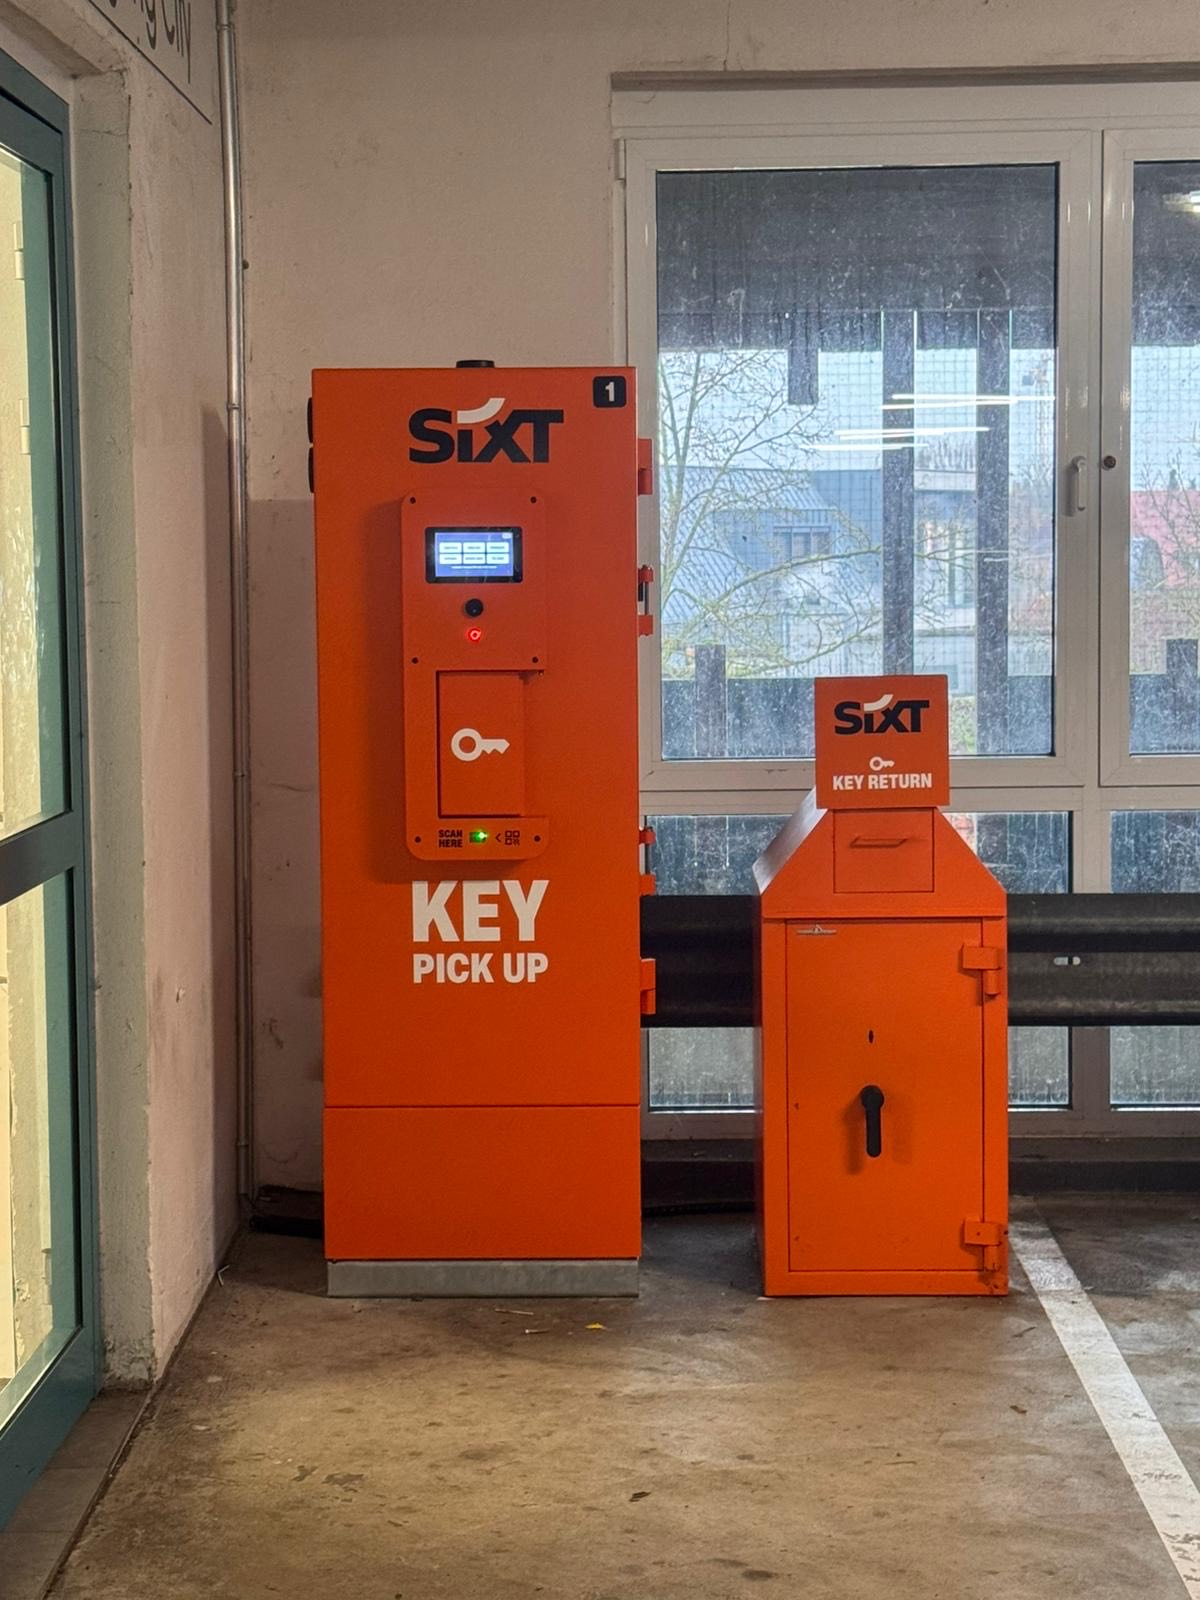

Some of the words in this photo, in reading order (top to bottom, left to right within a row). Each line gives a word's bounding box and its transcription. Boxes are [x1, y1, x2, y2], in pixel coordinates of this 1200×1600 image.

[604, 381, 616, 402] 1
[832, 775, 865, 790] KEY
[869, 773, 932, 789] RETURN
[438, 829, 463, 838] SCAN
[438, 839, 463, 848] HERE
[412, 880, 549, 942] KEY
[413, 953, 495, 984] PICK
[503, 953, 549, 984] UP
